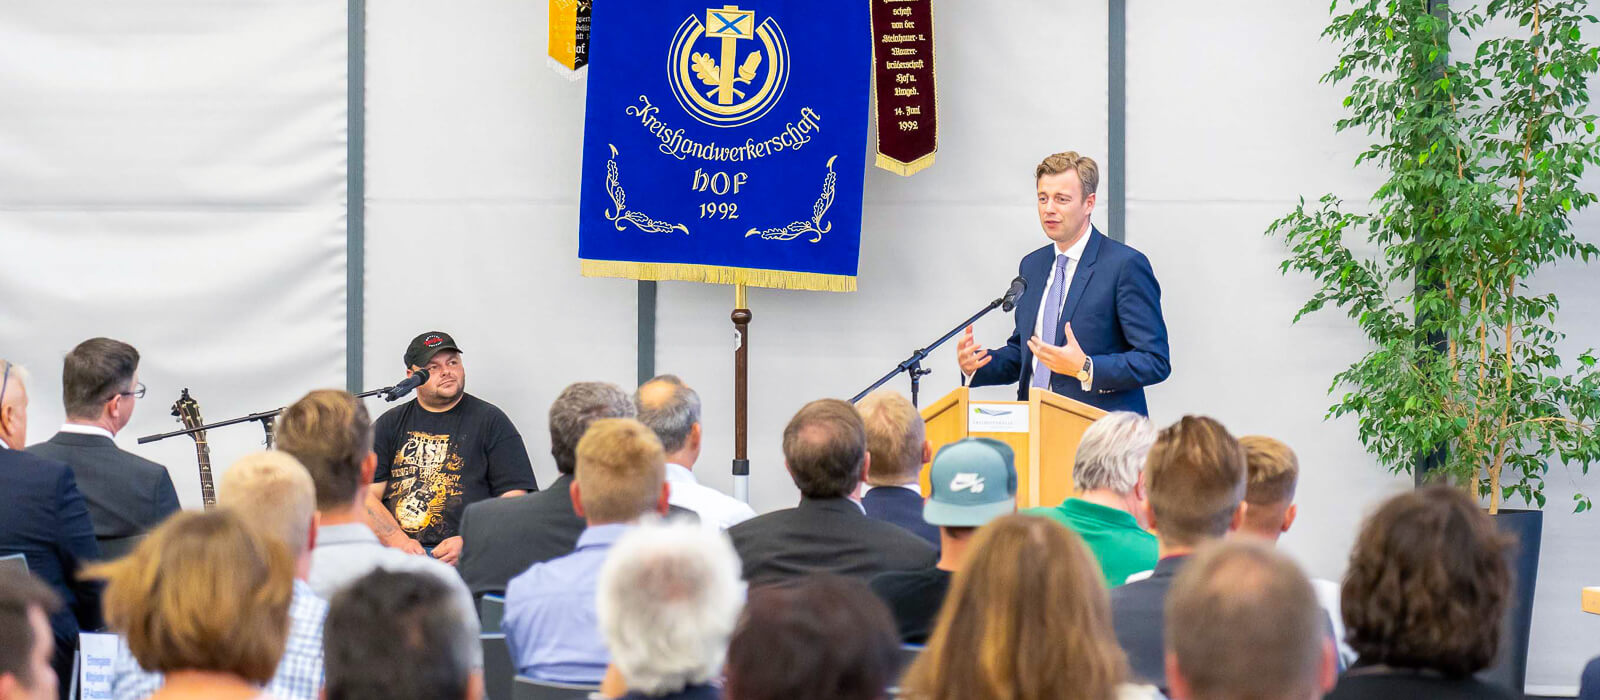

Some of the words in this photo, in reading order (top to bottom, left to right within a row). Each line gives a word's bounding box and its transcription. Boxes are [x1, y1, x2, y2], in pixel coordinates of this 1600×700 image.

[904, 20, 915, 29] der
[896, 73, 910, 84] Hof
[894, 107, 905, 116] 14.
[906, 105, 921, 117] Juni
[625, 94, 821, 163] Kreishandwerkerschaft
[898, 120, 919, 131] 1992
[699, 202, 739, 220] 1992
